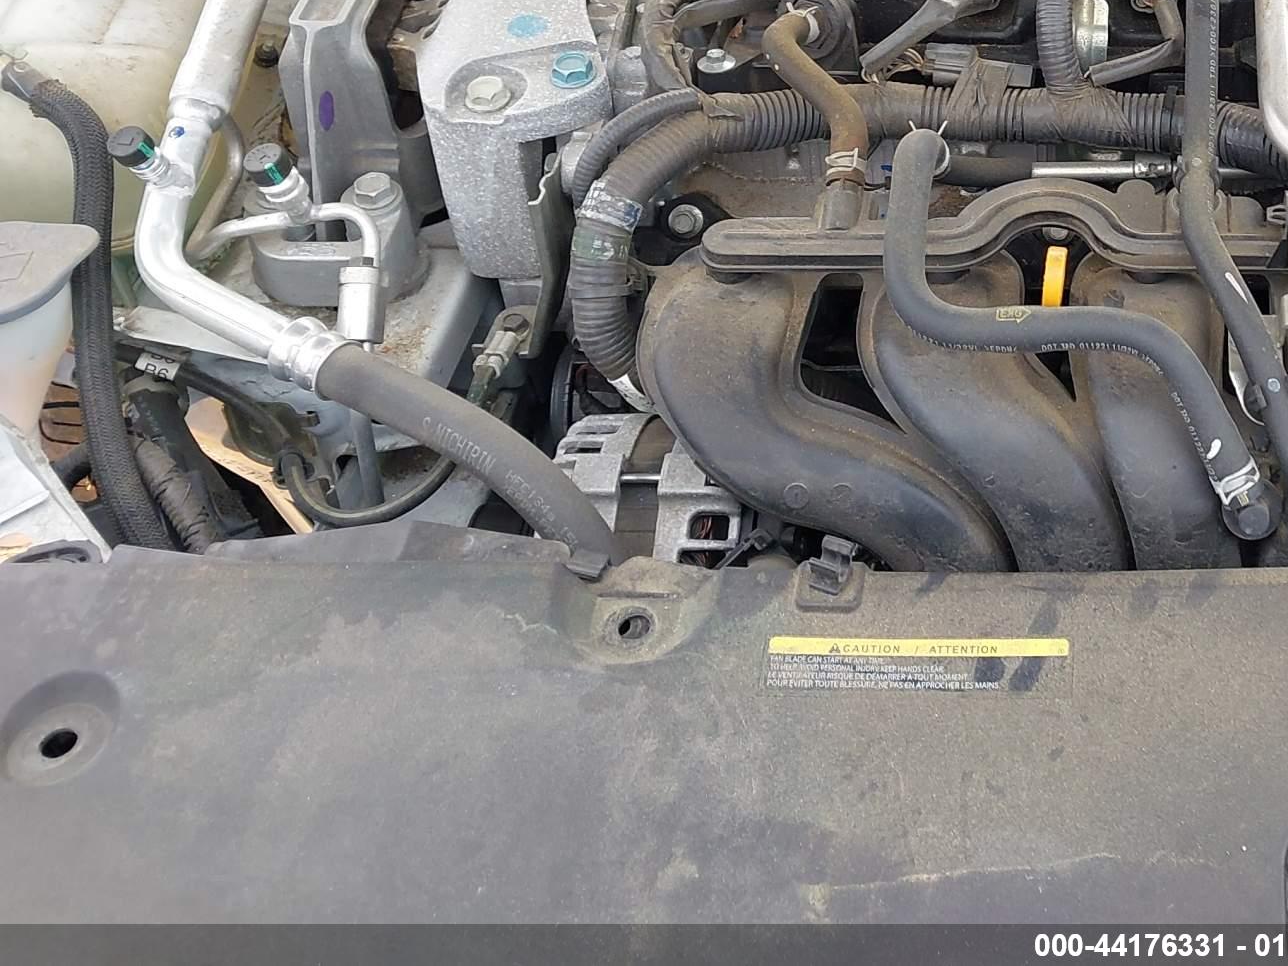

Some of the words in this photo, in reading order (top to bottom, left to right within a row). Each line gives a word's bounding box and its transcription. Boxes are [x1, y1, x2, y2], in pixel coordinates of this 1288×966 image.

[436, 422, 497, 476] NICHIRIN
[843, 644, 901, 654] CAUTION
[929, 645, 998, 655] ATTENTION
[807, 656, 822, 664] CAN
[820, 664, 856, 672] PERSONAL
[898, 665, 922, 673] HANDS
[827, 672, 854, 681] RISQUE
[913, 673, 934, 681] TOUT
[767, 679, 789, 687] POUR
[814, 680, 839, 688] TOUTE
[916, 681, 960, 690] APPROCHER
[960, 681, 974, 690] LES
